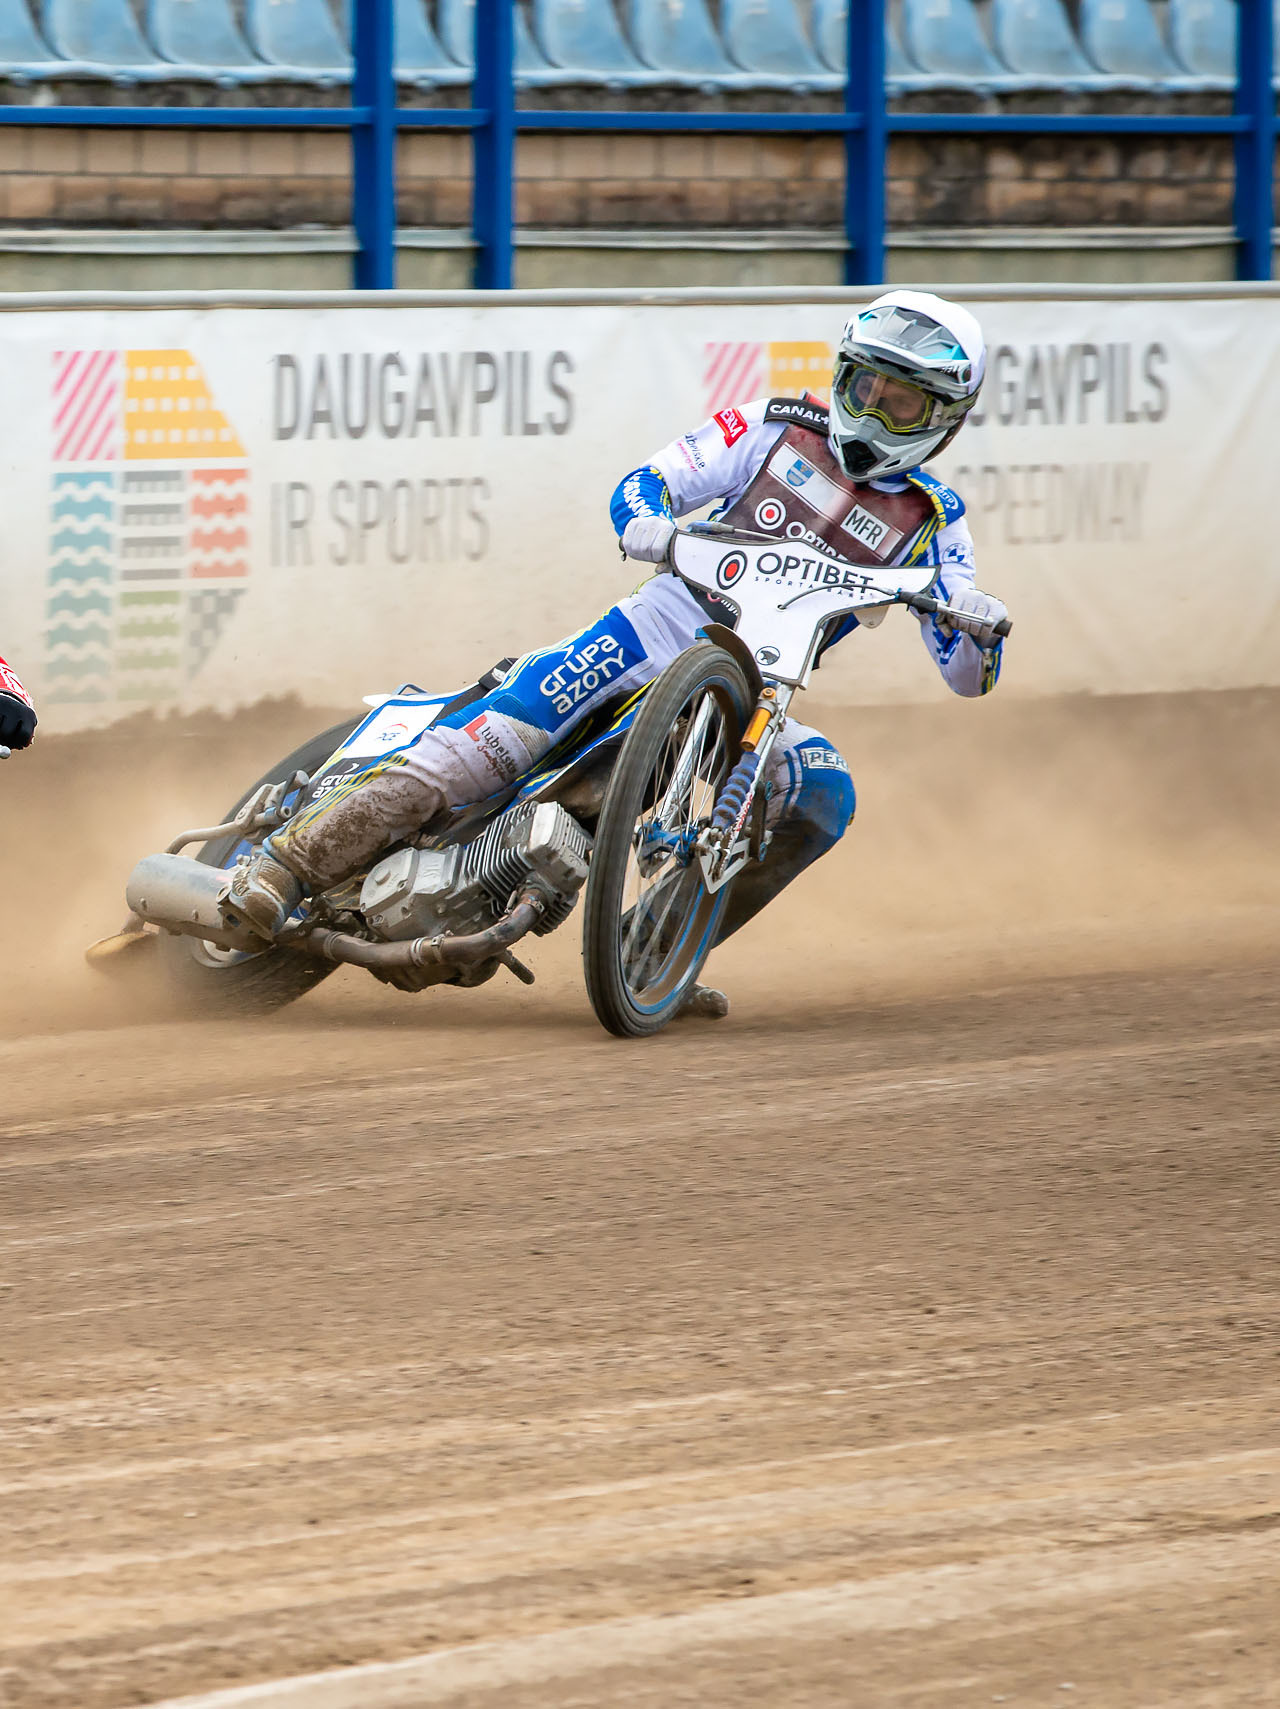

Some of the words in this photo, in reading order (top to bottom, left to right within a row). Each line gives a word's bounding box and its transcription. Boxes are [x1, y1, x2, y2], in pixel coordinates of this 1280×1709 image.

[273, 350, 576, 440] DAUGAVPILS
[969, 342, 1170, 427] GAVPILS
[720, 408, 744, 439] ERLA
[769, 404, 829, 424] CANAL+
[271, 480, 313, 567] IR
[328, 476, 492, 565] SPORTS
[846, 509, 884, 545] MFR
[754, 576, 815, 589] SPORTA
[756, 552, 874, 594] OPTIBET
